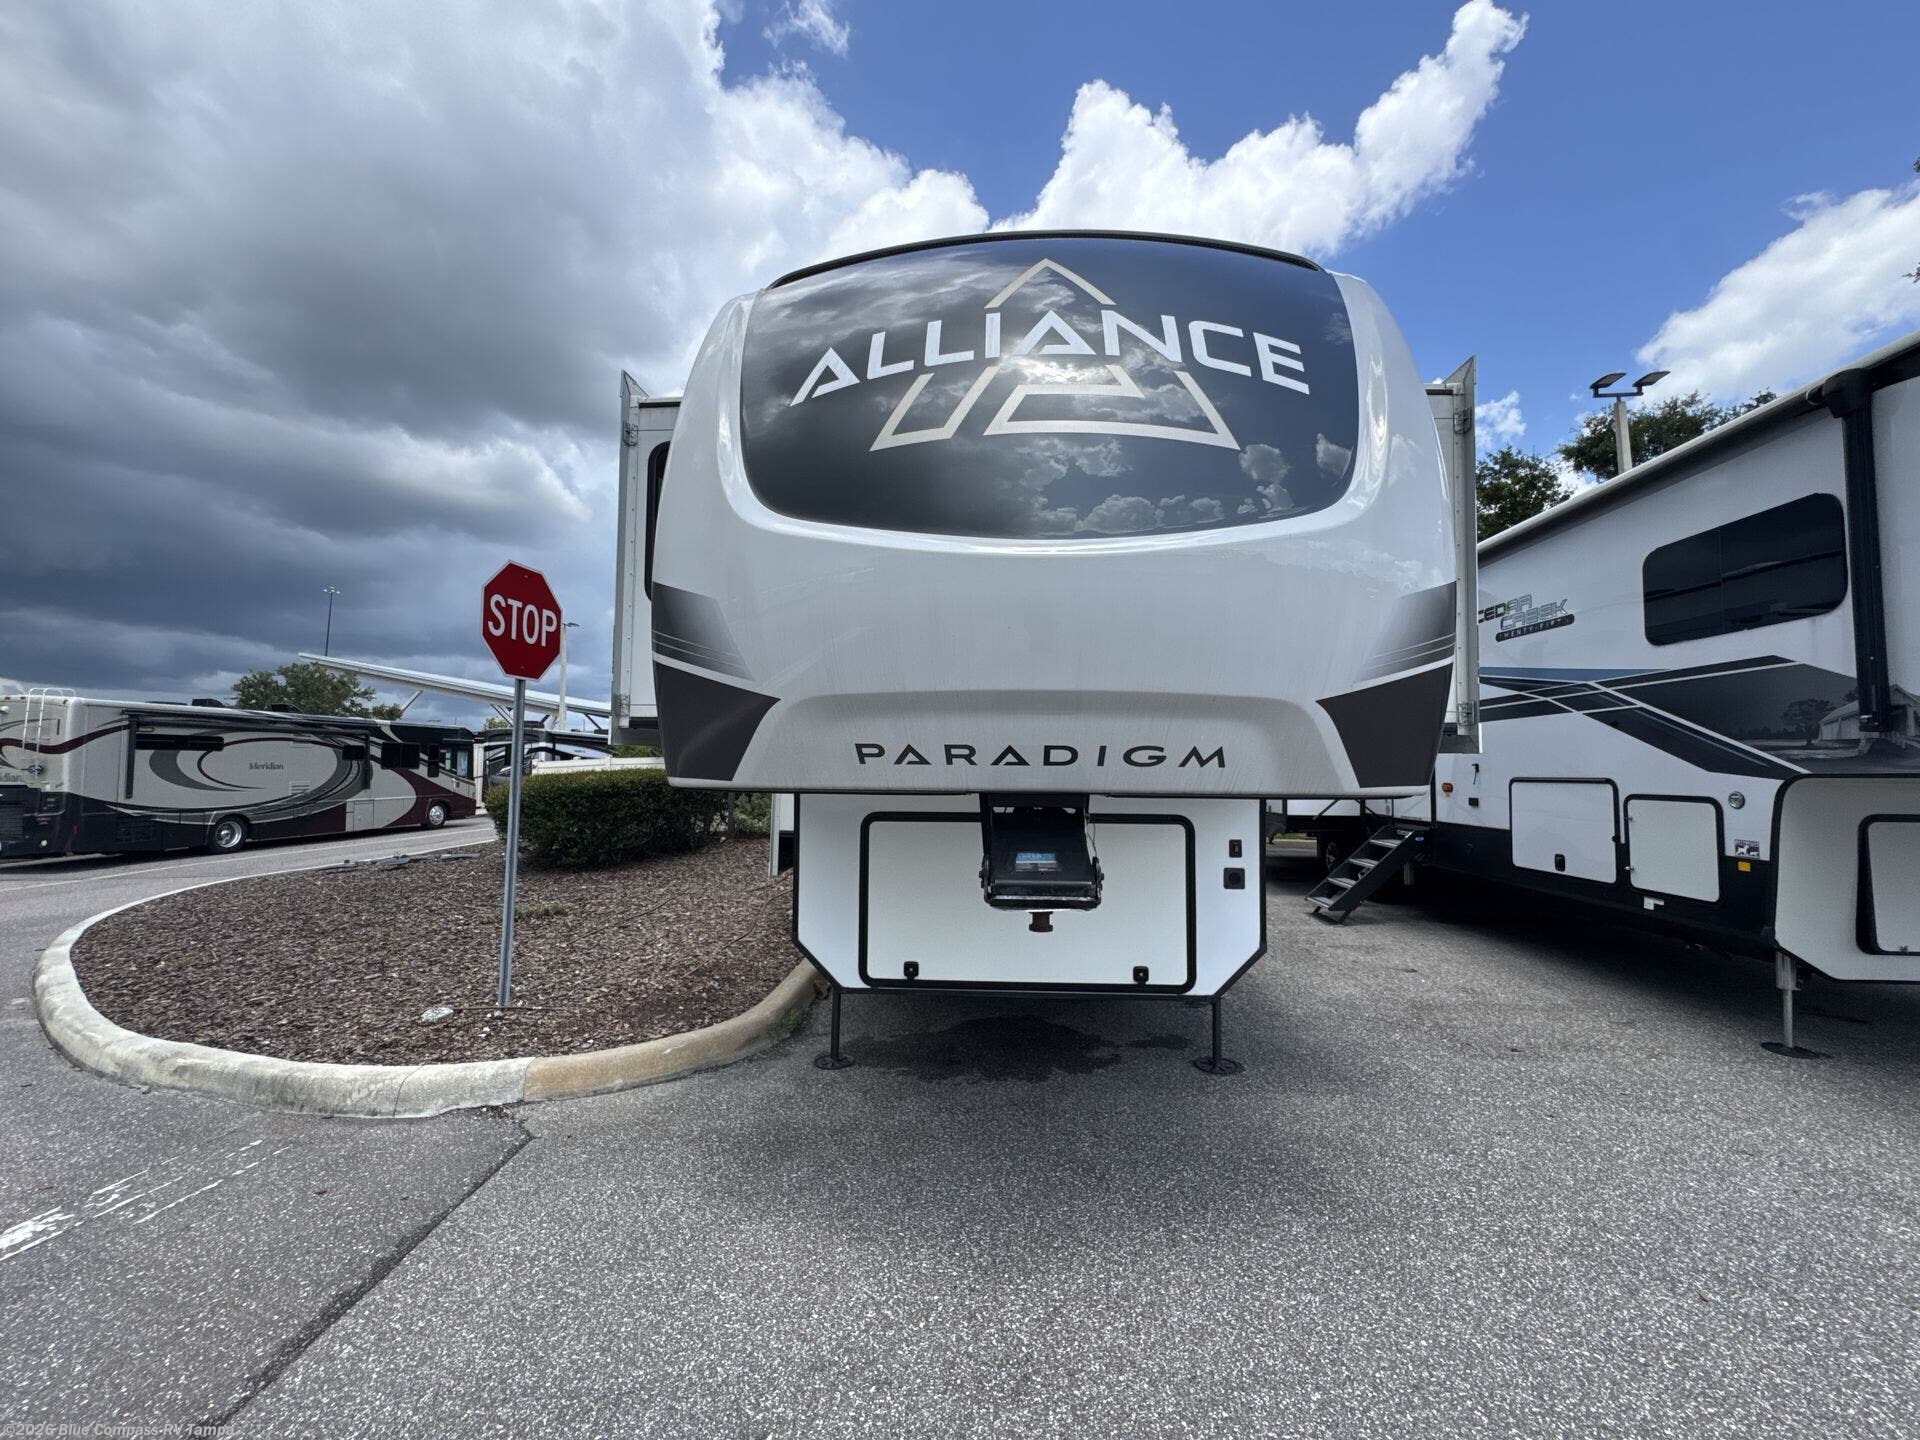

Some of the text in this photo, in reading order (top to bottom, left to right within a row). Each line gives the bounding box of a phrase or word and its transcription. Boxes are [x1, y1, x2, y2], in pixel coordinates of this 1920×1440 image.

[789, 309, 1310, 407] ALLIANCE
[488, 594, 557, 647] STOP
[1501, 598, 1568, 630] CREEK
[854, 743, 1226, 769] PARADIGM
